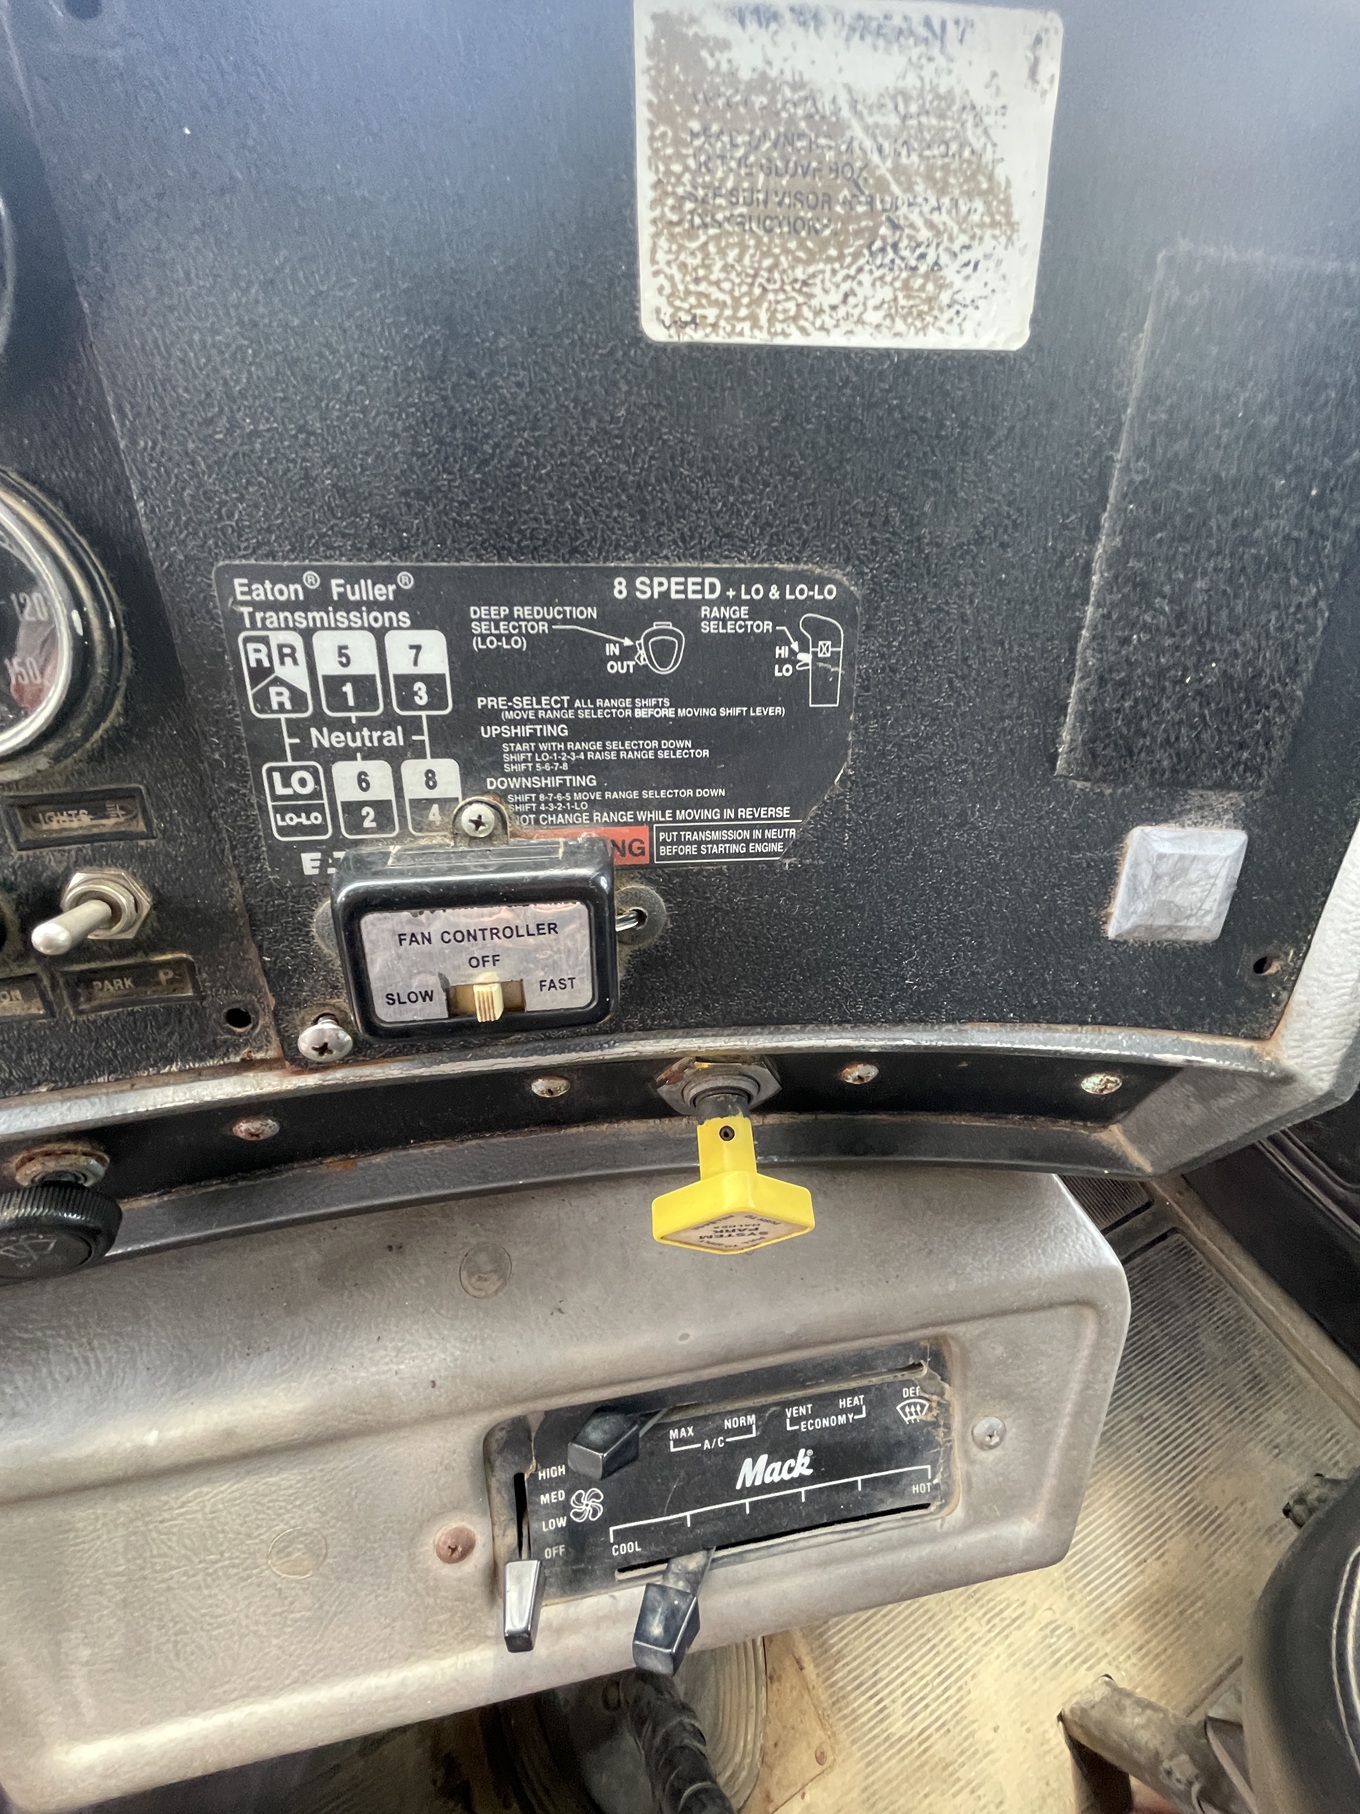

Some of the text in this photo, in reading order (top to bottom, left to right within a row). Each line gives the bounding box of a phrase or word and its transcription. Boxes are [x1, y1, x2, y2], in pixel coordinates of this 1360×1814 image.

[729, 187, 769, 209] SUN
[775, 189, 833, 211] VISOR
[613, 577, 628, 600] 8
[635, 576, 722, 600] SPEED
[741, 584, 764, 600] LO
[768, 584, 781, 600] &
[785, 583, 837, 600] LO-LO
[10, 591, 49, 622] 120
[470, 605, 598, 620] DEEP REDUCTION
[700, 605, 750, 619] RANGE
[239, 606, 412, 629] Transmissions
[471, 620, 549, 635] SELECTOR
[700, 620, 773, 634] SELECTOR
[472, 636, 527, 651] (LO-LO)
[605, 643, 620, 656] IN
[246, 642, 271, 668] R
[276, 642, 300, 667] R
[337, 643, 352, 669] 5
[408, 643, 423, 667] 7
[775, 645, 789, 658] HI
[4, 656, 43, 685] 150
[607, 660, 635, 675] OUT
[774, 664, 793, 677] LO
[269, 686, 293, 711] R
[342, 682, 356, 707] 1
[413, 681, 429, 706] 3
[477, 695, 670, 710] PRE-SELECT ALL RANGE SHIFTS
[501, 706, 785, 721] (MOVE RANGE SELECTOR BEFORE MOVING SHIFT LEVER)
[310, 725, 404, 748] Neutral
[481, 724, 569, 738] UPSHIFTING
[502, 739, 692, 752] START WITH RANGE SELECTOR DOWN
[503, 749, 710, 762] SHIFT LO-1-2-3-4 RAISE RANGE SELECTOR
[504, 761, 569, 772] SHIFT 5-6-7-8
[271, 770, 315, 796] LO
[356, 770, 371, 793] 6
[424, 768, 438, 791] 8
[486, 775, 597, 790] DOWNSHIFTING
[507, 788, 726, 803] SHIFT 8-7-6-5 MOVE RANGE SELECTOR DOWN
[428, 803, 443, 825] 4
[509, 801, 588, 812] SHIFT 4-3-2-1-LO
[276, 812, 323, 826] LO-LO
[361, 806, 377, 829] 2
[539, 813, 590, 825] CHANGE
[593, 811, 634, 823] RANGE
[636, 810, 673, 821] WHILE
[676, 808, 720, 820] MOVING
[724, 808, 735, 819] IN
[737, 807, 790, 819] REVERSE
[659, 828, 796, 842] PUT TRANSMISSION IN NEUTR
[659, 844, 698, 856] BEFORE
[700, 843, 747, 855] STARTING
[749, 842, 784, 853] ENGINE
[398, 922, 559, 947] FAN CONTROLLER
[468, 954, 501, 969] OFF
[539, 977, 577, 992] FAST
[385, 989, 434, 1006] SLOW
[903, 1386, 921, 1399] DEF
[785, 1395, 865, 1418] VENT HEAT
[669, 1414, 756, 1440] MAX NORM
[800, 1415, 854, 1432] ECONOMY
[703, 1437, 725, 1451] A/C
[537, 1464, 566, 1480] HIGH
[912, 1482, 932, 1495] HOT
[540, 1490, 566, 1505] MED
[542, 1516, 568, 1531] LOW
[544, 1544, 566, 1559] OFF
[611, 1541, 642, 1556] COOL
